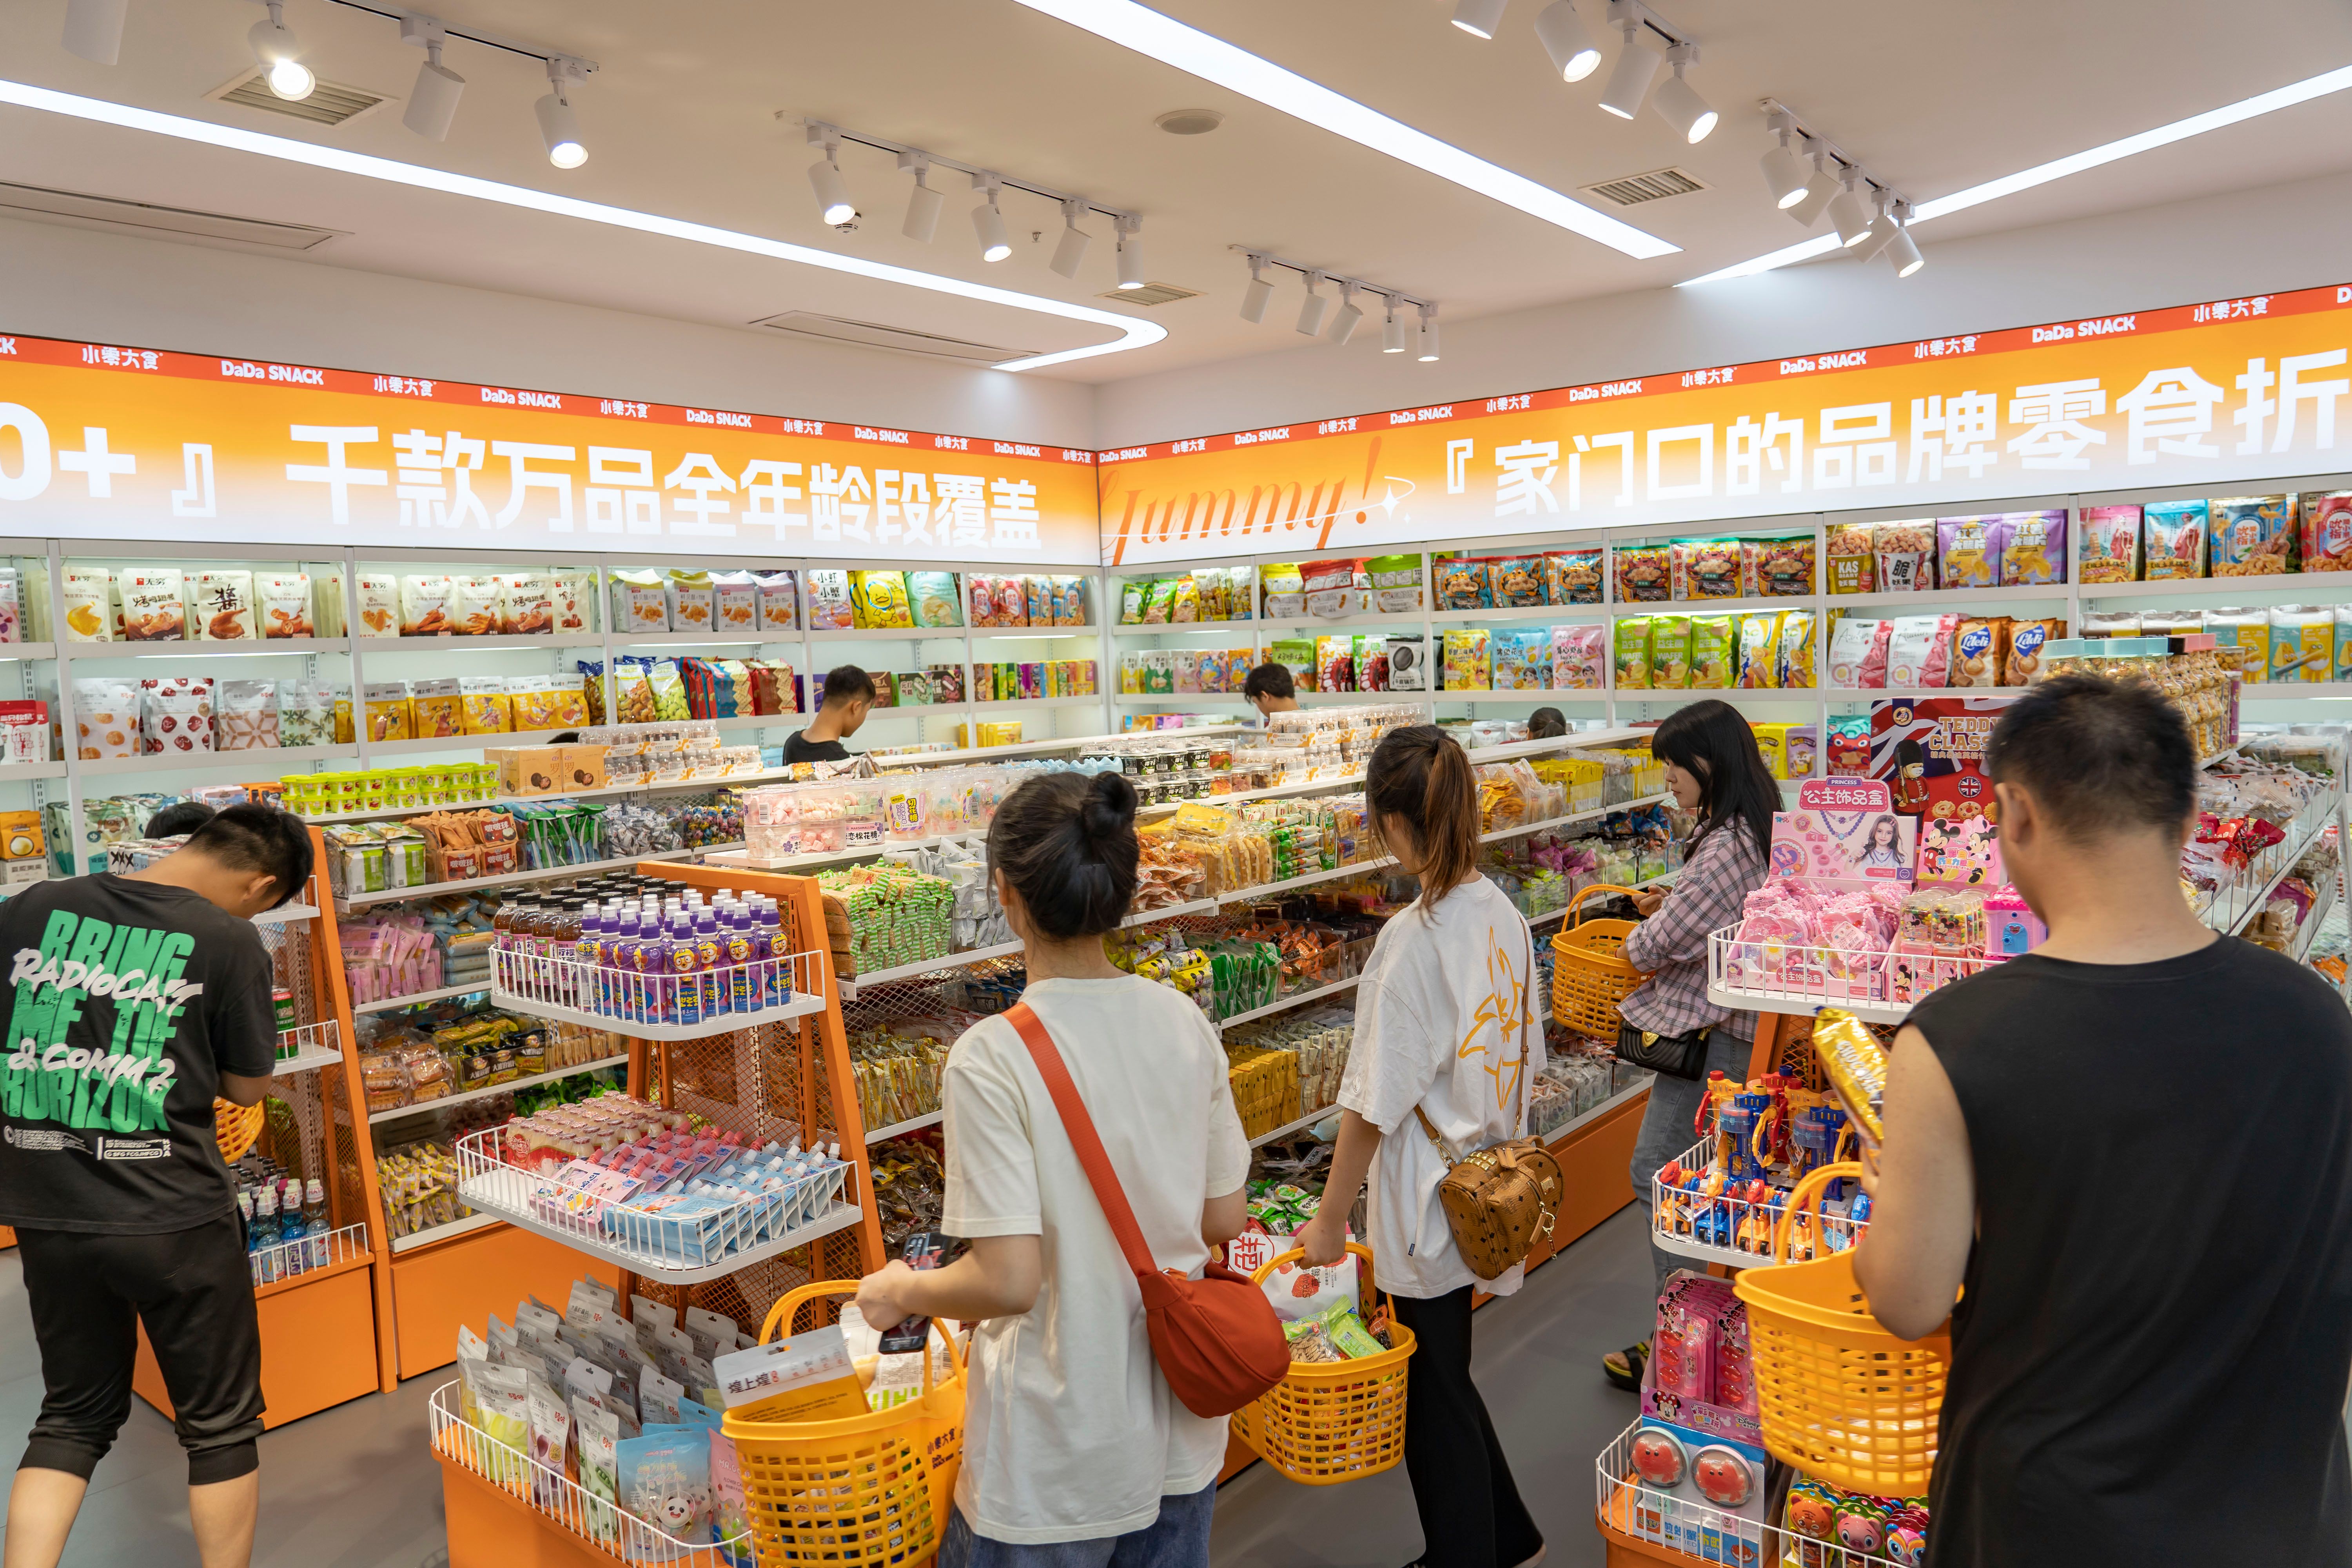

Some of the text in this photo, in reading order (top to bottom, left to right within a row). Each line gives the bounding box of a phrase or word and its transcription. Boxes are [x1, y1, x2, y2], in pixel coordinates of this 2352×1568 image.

[2194, 296, 2269, 322] 小零大食
[2033, 316, 2136, 343] DaDa SNACK
[1915, 335, 1977, 358] 小零大食
[82, 345, 158, 370] 小零大食
[1780, 351, 1866, 374] DaDa SNACK
[221, 361, 323, 385] DaDa SNACK
[1682, 367, 1734, 387] 小零大食
[374, 376, 433, 397] 小零大食
[1570, 380, 1642, 401] DaDa SNACK
[481, 388, 561, 408] DaDa SNACK
[1486, 395, 1530, 412] 小零大食
[601, 400, 648, 418] 小零大食
[1390, 406, 1452, 424] DaDa SNACK
[686, 410, 751, 427] DaDa SNACK
[1319, 417, 1357, 434] 小零大食
[784, 419, 822, 435] 小零大食
[855, 427, 909, 443] DaDa SNACK
[935, 436, 967, 450] 小零大食
[1235, 428, 1289, 445] DaDa SNACK
[994, 442, 1040, 457] DaDa SNACK
[1172, 439, 1205, 454] 小零大食
[1063, 450, 1091, 463] 小零大食
[1100, 447, 1147, 463] DaDa SNACK
[286, 424, 1042, 549] 千款万品全年龄段覆盖
[1838, 561, 1859, 573] KAS
[1892, 559, 1911, 578] 脆
[818, 573, 837, 584] 小虾
[1621, 640, 1644, 648] 益生菌
[1657, 639, 1684, 648] 益生菌
[1698, 639, 1721, 648] 益生菌
[1621, 652, 1643, 660] WAFER
[1657, 652, 1683, 660] WAFER
[1697, 652, 1720, 660] WAFER
[550, 763, 560, 776] 罗
[565, 762, 575, 774] 罗
[1802, 787, 1884, 806] 公主饰品盒
[907, 798, 918, 822] 切花糖
[846, 831, 878, 840] 恋棉花糖
[38, 909, 196, 998] BRING
[558, 948, 575, 956] 柠檬
[1311, 1268, 1321, 1287] 草莓
[728, 1372, 772, 1394] 煌上煌
[508, 1392, 524, 1402] 百草味
[555, 1410, 566, 1425] 百草味
[603, 1436, 613, 1451] 百草味
[724, 1477, 736, 1486] FLOWER
